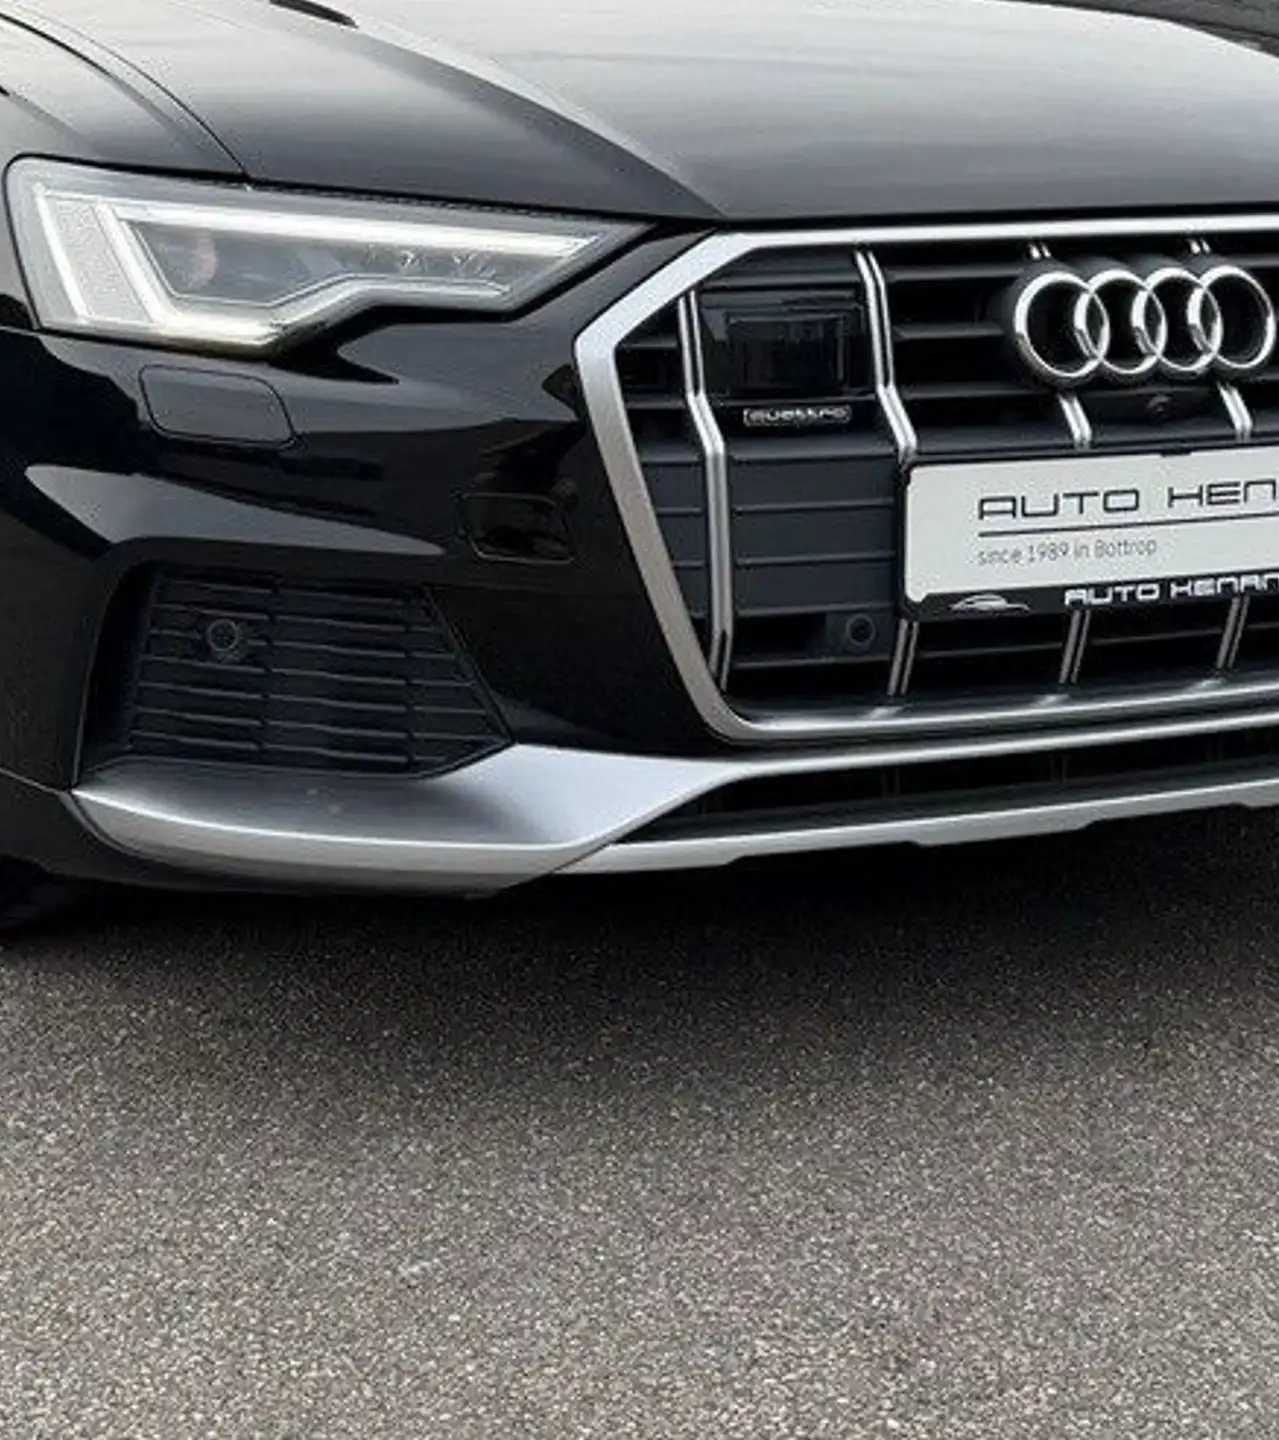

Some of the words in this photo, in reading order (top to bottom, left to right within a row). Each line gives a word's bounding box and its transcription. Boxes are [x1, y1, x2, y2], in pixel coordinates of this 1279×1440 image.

[978, 488, 1140, 520] AUTO
[977, 546, 1023, 566] since
[1027, 541, 1070, 563] 1989
[1073, 539, 1090, 559] in
[1093, 537, 1158, 559] Bottrop
[1064, 583, 1161, 607] AUTO
